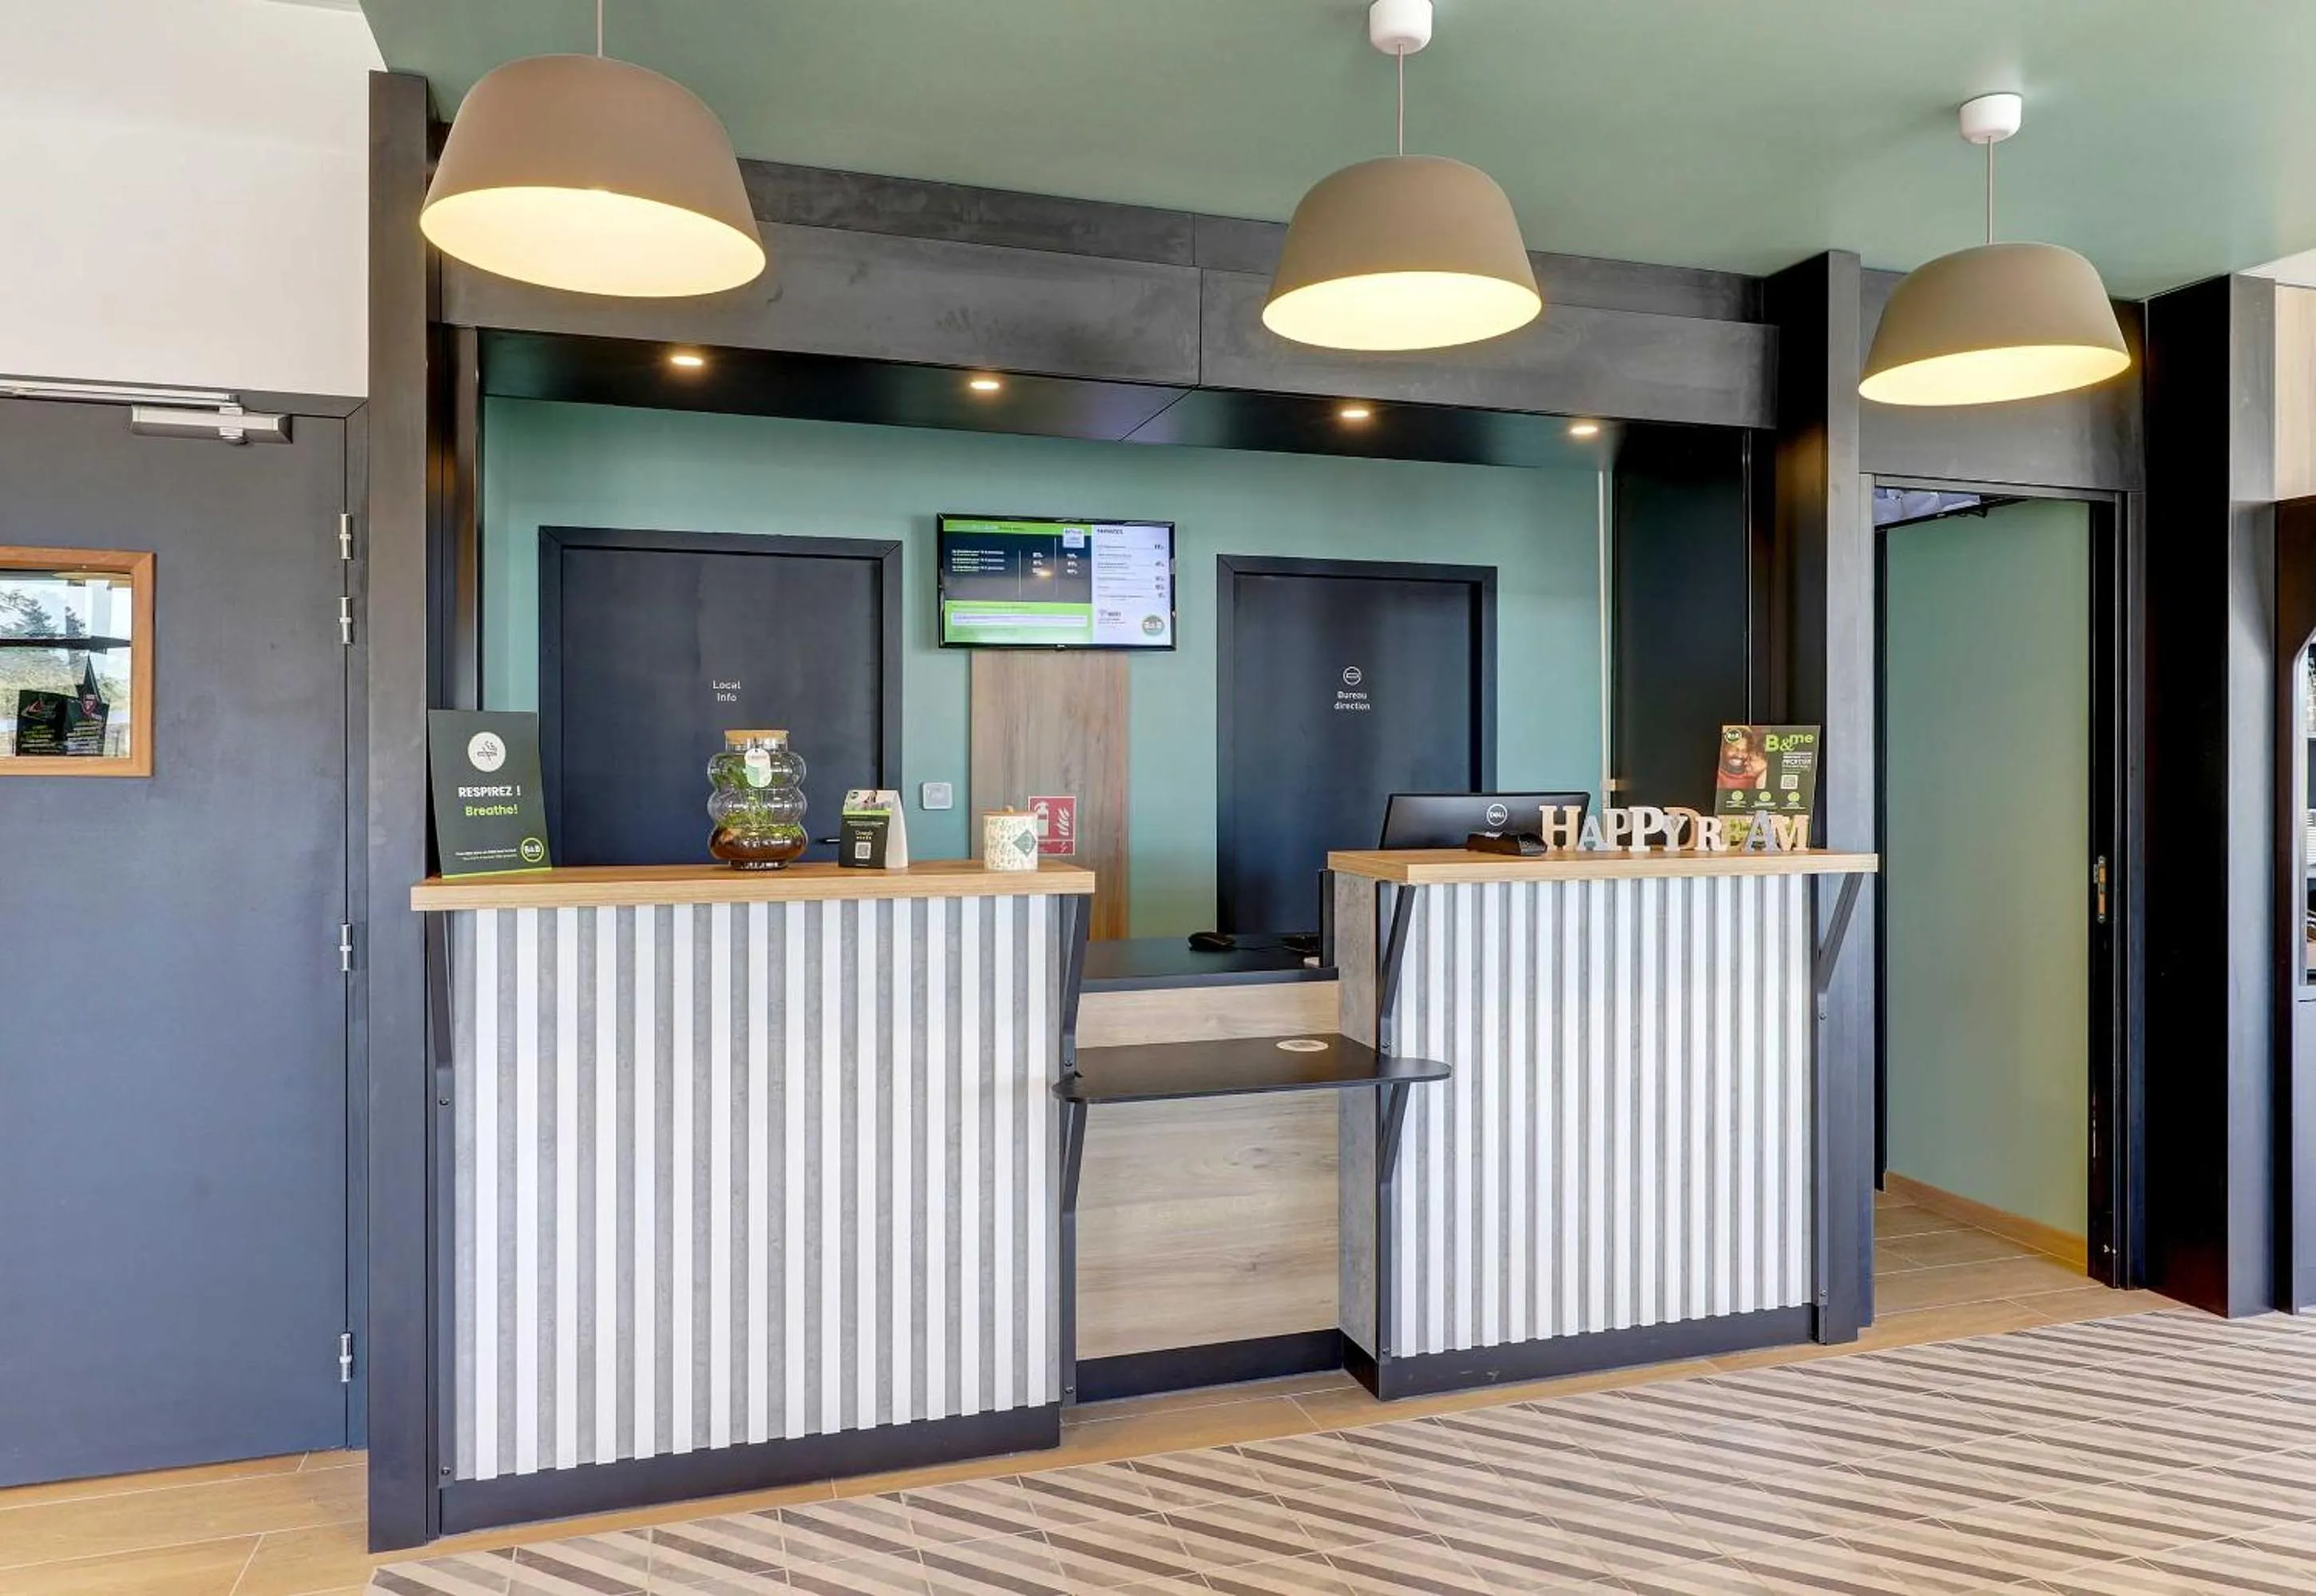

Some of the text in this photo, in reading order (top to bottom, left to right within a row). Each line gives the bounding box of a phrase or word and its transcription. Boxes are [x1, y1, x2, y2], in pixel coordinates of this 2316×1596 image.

[712, 679, 741, 689] Local
[717, 692, 737, 702] Info
[1765, 734, 1814, 752] B&me
[458, 786, 513, 798] RESPIREZ
[465, 804, 518, 817] Breathe!
[1539, 805, 1688, 852] HAPPY
